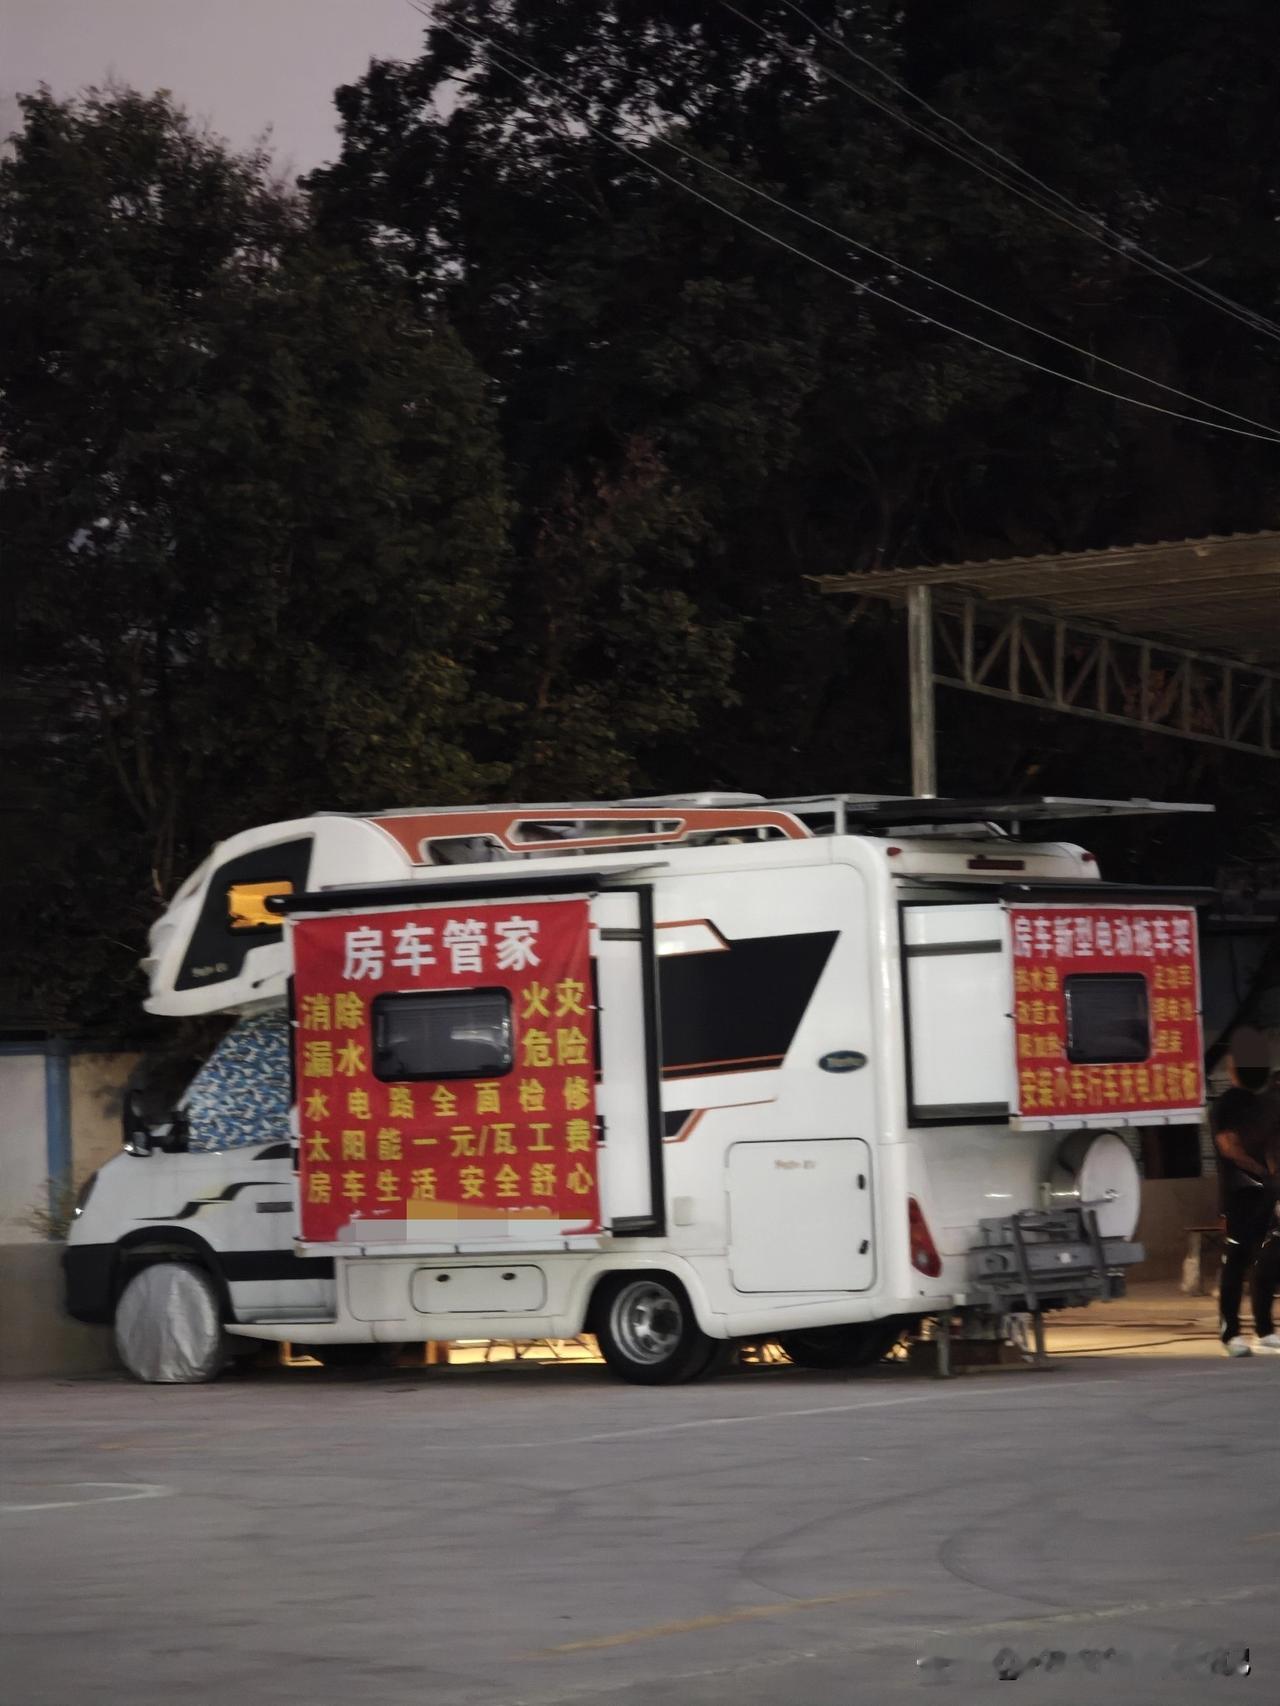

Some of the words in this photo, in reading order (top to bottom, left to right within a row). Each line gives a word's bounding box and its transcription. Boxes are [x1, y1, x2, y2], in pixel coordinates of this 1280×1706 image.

[343, 915, 541, 981] 房车管家
[301, 991, 365, 1031] 消除
[520, 978, 587, 1019] 火灾
[303, 1039, 366, 1079] 漏水
[521, 1026, 590, 1068] 危险
[305, 1076, 590, 1121] 水电路全面检修
[306, 1118, 591, 1163] 太阳能一元/瓦工费
[307, 1167, 438, 1205] 房车生活
[459, 1162, 593, 1199] 安全舒心
